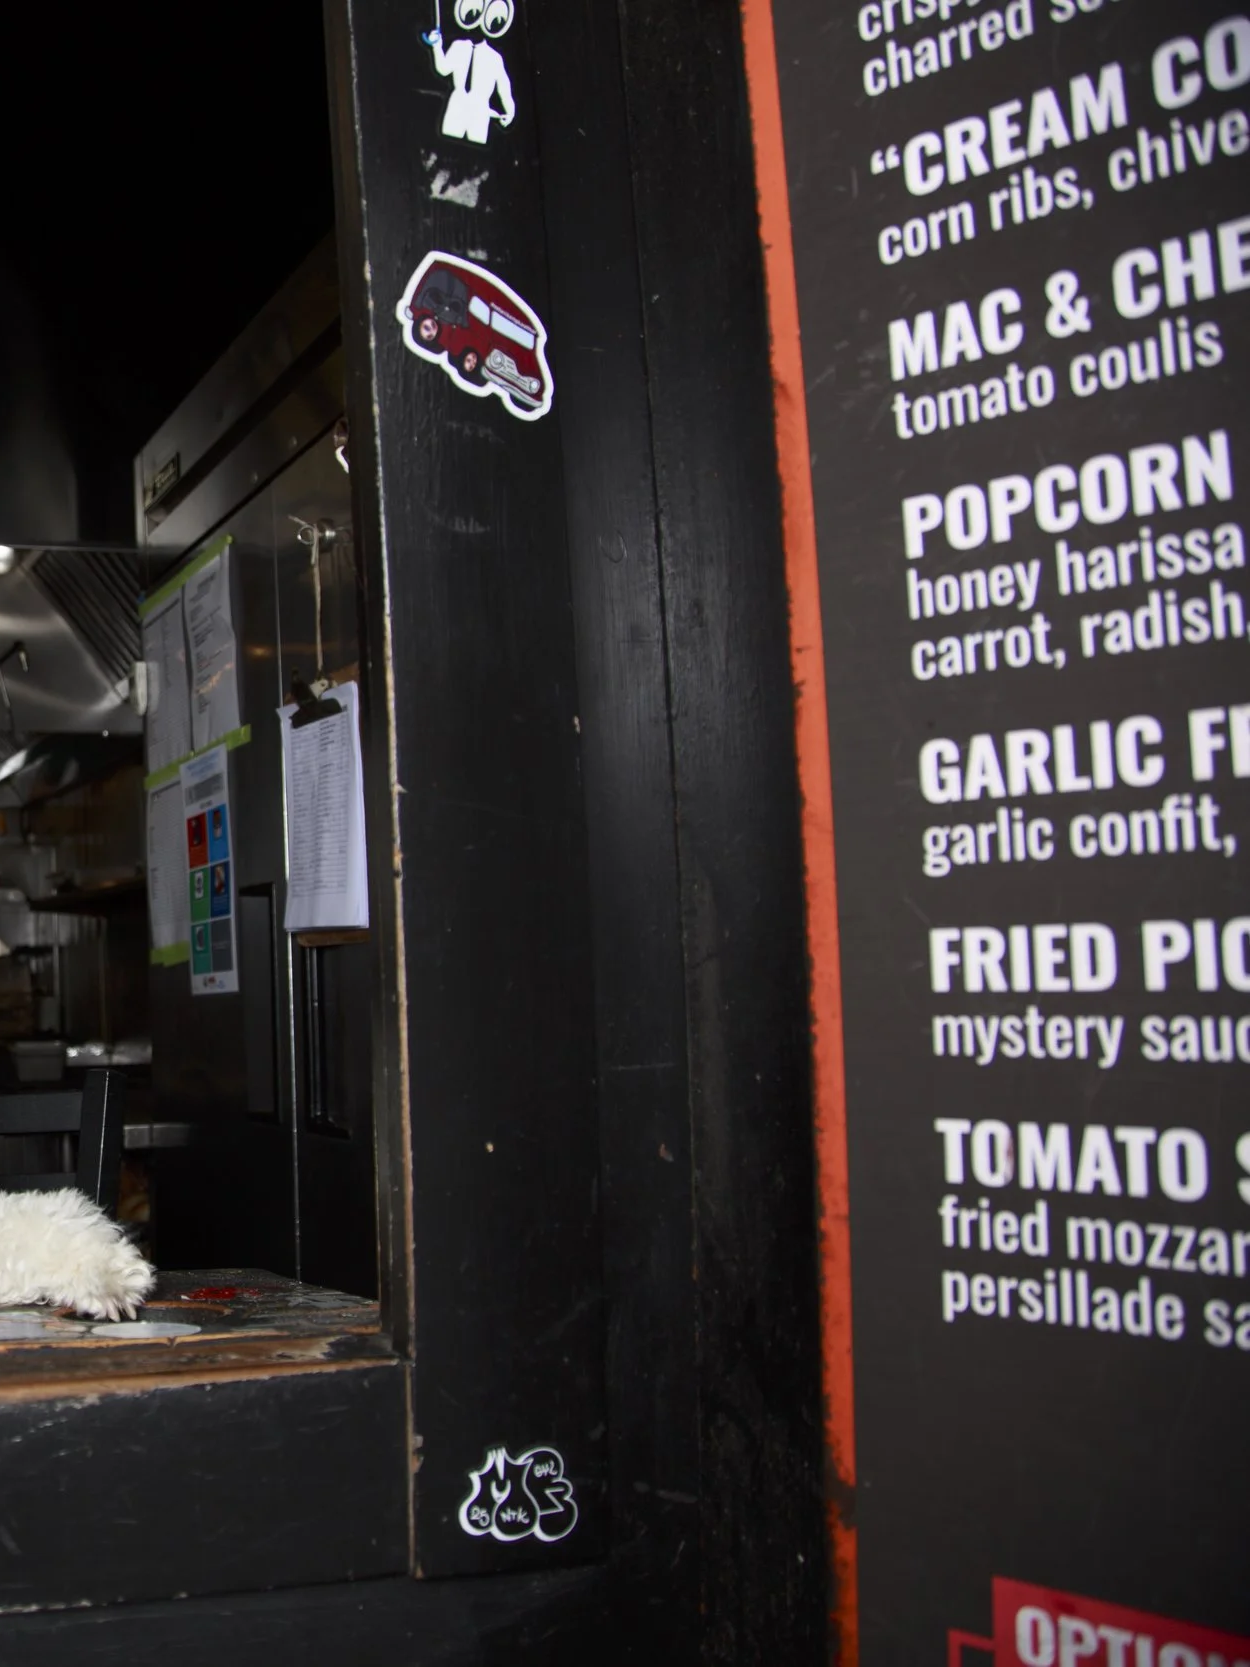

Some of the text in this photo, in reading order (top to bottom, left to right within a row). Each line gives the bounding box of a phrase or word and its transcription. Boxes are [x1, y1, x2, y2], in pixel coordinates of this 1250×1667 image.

[862, 0, 1035, 96] charred
[1152, 15, 1250, 110] CO
[878, 109, 1250, 265] corn ribs, chive
[888, 214, 1250, 381] MAC & CHE
[891, 315, 1224, 440] tomato coulis
[902, 429, 1233, 560] POPCORN
[906, 522, 1245, 621] honey harissa
[911, 579, 1250, 680] carrot, radish
[919, 714, 1166, 804] GARLIC
[922, 794, 1237, 877] garlic confit,
[929, 922, 1118, 993] FRIED
[932, 1005, 1124, 1069] mystery
[934, 1117, 1210, 1203] TOMATO
[938, 1194, 1050, 1257] fried
[942, 1268, 1185, 1340] persillade
[1015, 1605, 1250, 1667] OPTI
